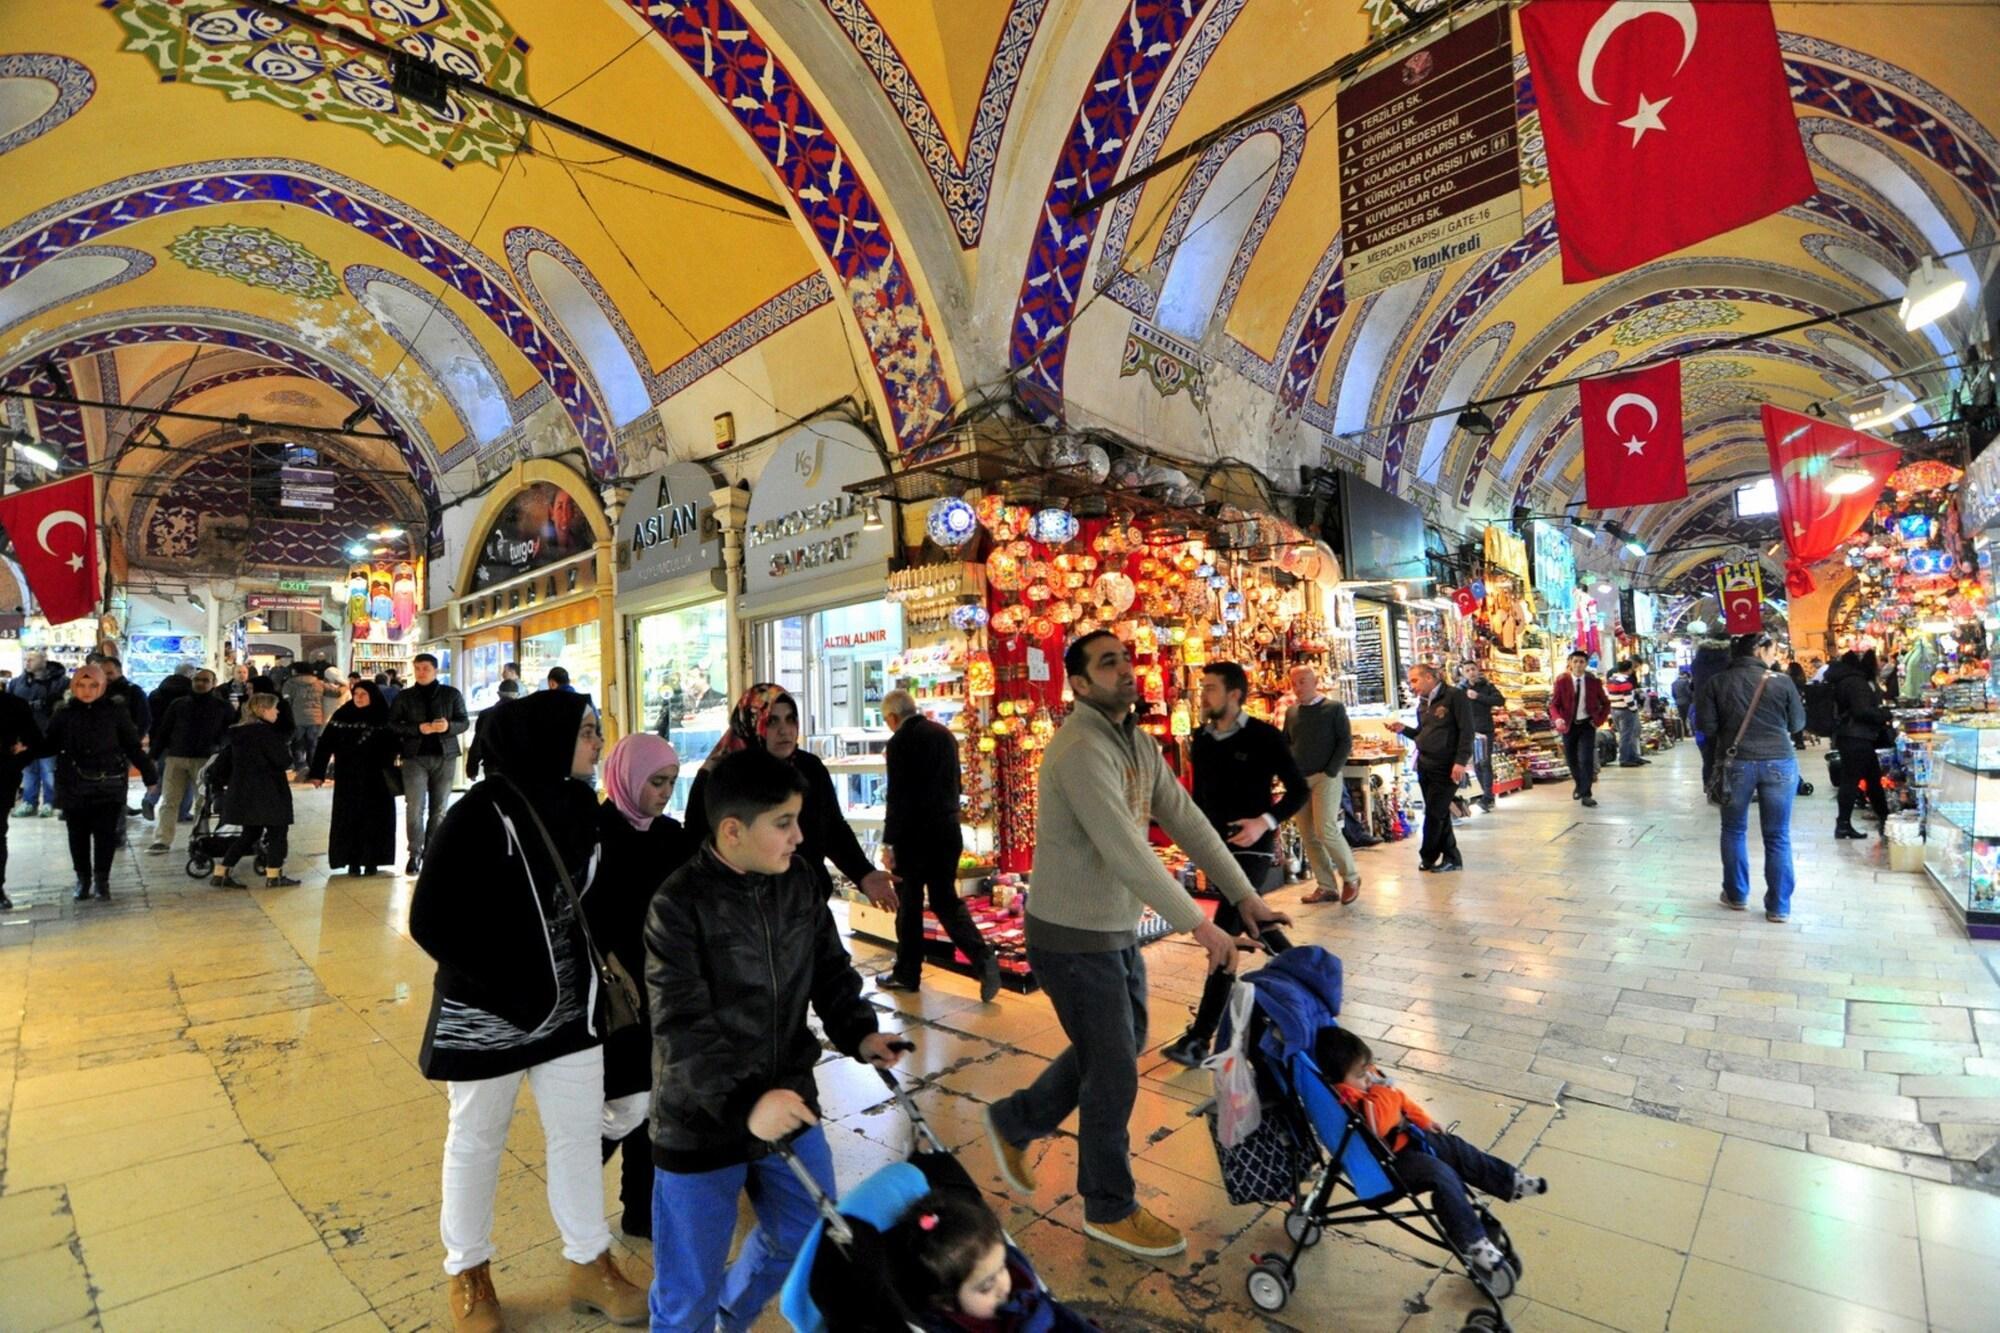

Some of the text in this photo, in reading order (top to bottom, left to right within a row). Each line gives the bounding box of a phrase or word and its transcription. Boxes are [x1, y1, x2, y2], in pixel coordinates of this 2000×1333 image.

[1361, 93, 1423, 130] TERZİLER SK.
[1361, 116, 1418, 150] DİVRİKLİ SK.
[1362, 112, 1460, 169] CEVAHİR BEDESTENİ
[1363, 129, 1477, 188] KOLANCILAR KAPISI SK.
[1364, 173, 1422, 207] KÜRKÇÜLER
[1423, 156, 1463, 183] ÇARŞISI
[1470, 144, 1488, 160] WC
[1365, 180, 1457, 226] KUYUMCULAR CAD.
[1366, 206, 1443, 246] TAKKECİLER SK.
[1367, 241, 1407, 264] MERCAN
[1408, 228, 1442, 248] KAPISI
[1448, 208, 1491, 233] GATE-16
[632, 500, 698, 552] ASLAN
[768, 531, 860, 577] SARRAF
[280, 582, 309, 592] EXIT
[824, 628, 887, 648] ALTIN ALINIR
